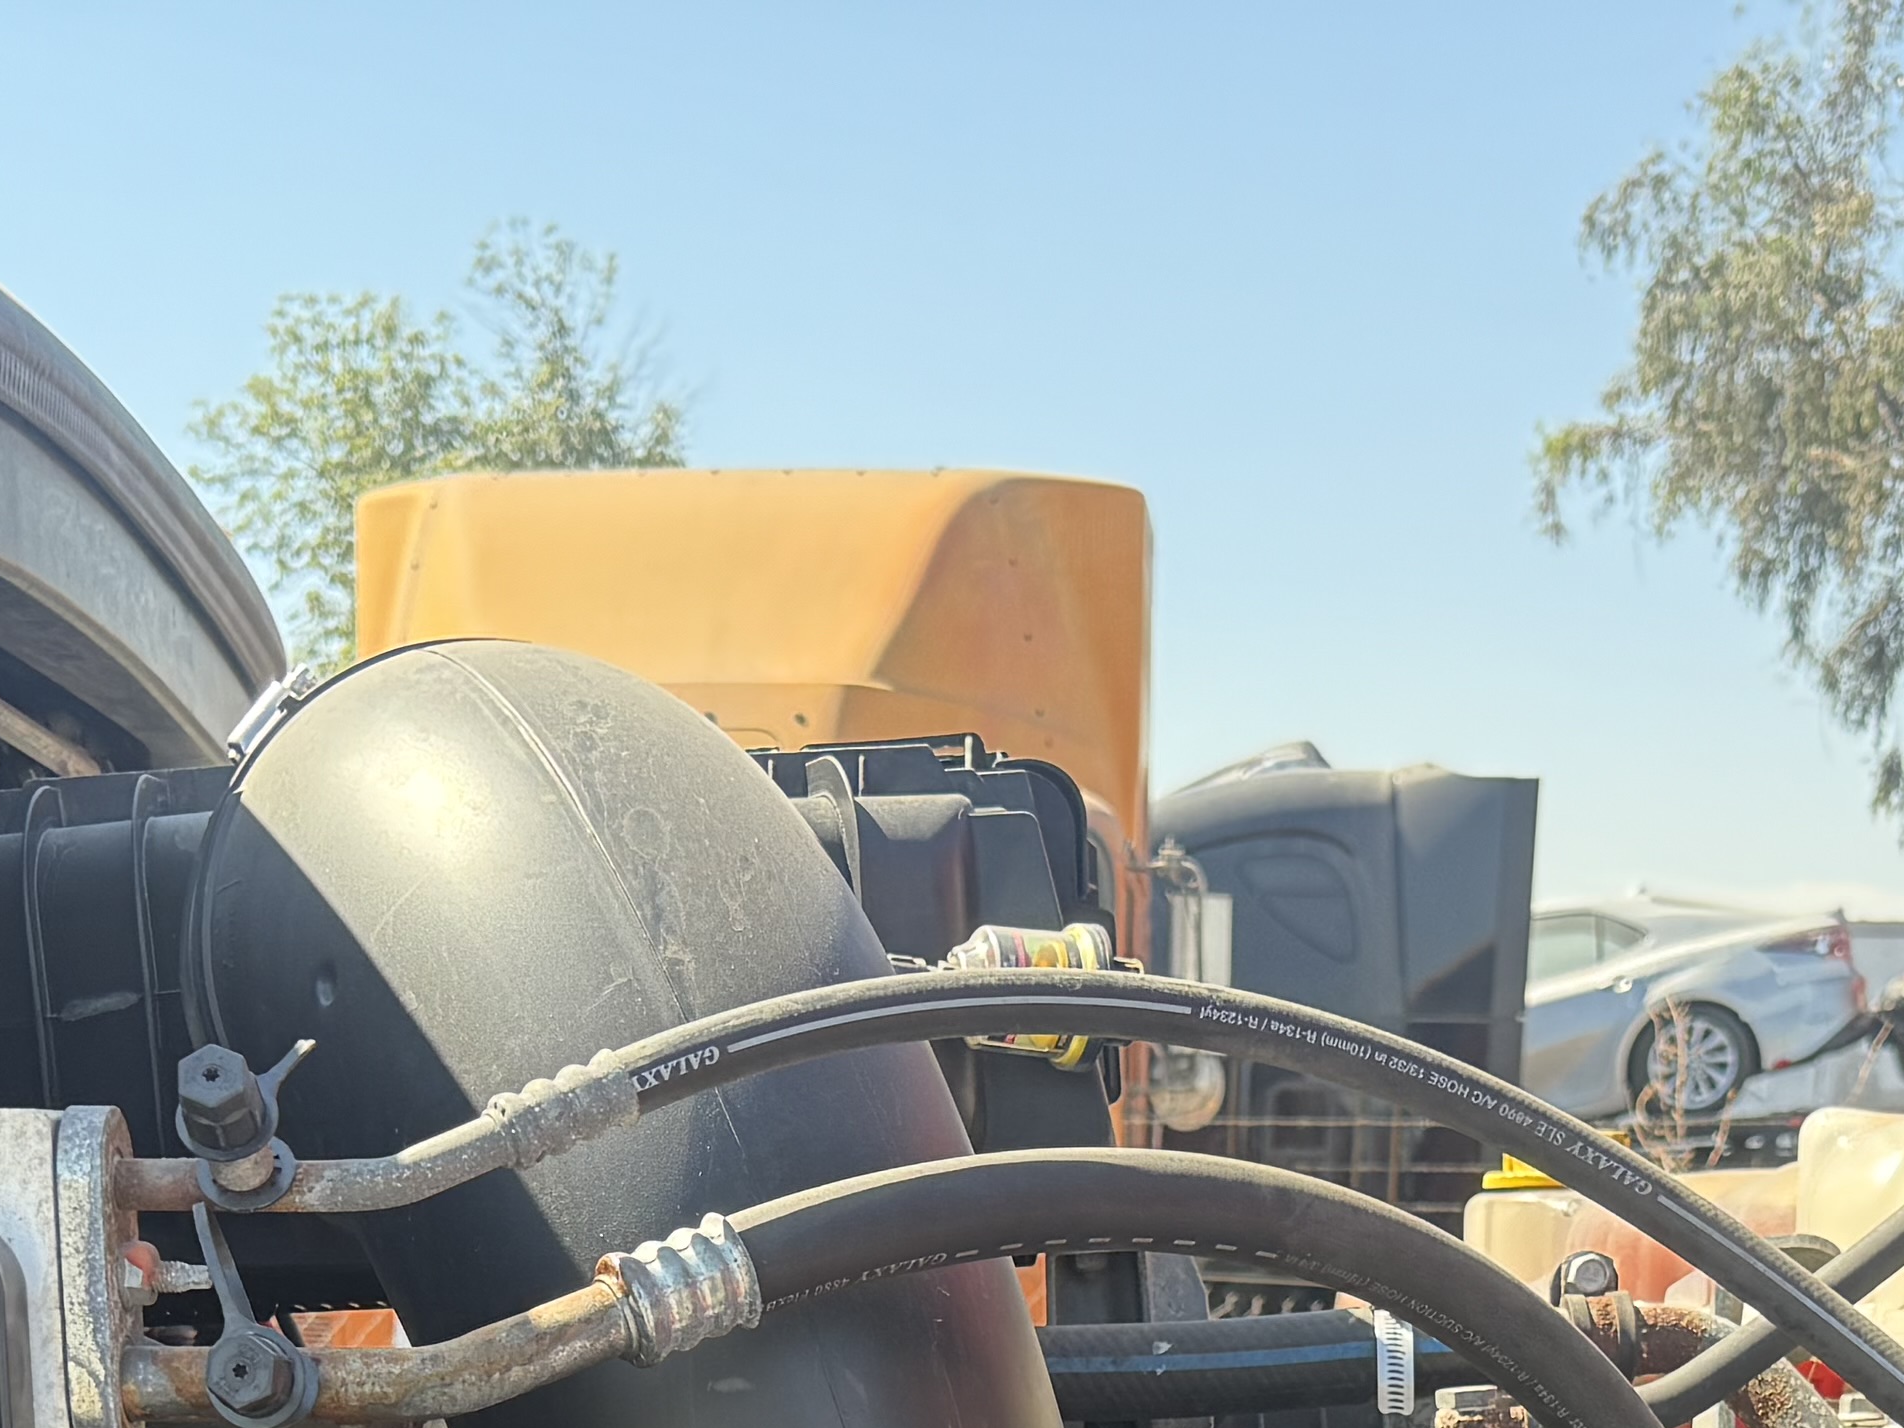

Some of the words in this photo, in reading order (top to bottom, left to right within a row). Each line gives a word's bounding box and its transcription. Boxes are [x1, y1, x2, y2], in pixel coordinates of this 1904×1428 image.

[1270, 1020, 1317, 1044] R-134a
[1321, 1032, 1372, 1060] (10mm)
[1374, 1051, 1388, 1065] in
[1428, 1070, 1469, 1098] HOSE
[1471, 1090, 1498, 1110] A/C
[1499, 1104, 1533, 1127] 4890
[1535, 1121, 1566, 1146] SLE
[1566, 1140, 1653, 1196] GALAXY
[853, 1252, 948, 1284] GALAXY
[1406, 1298, 1463, 1334] SUCTION
